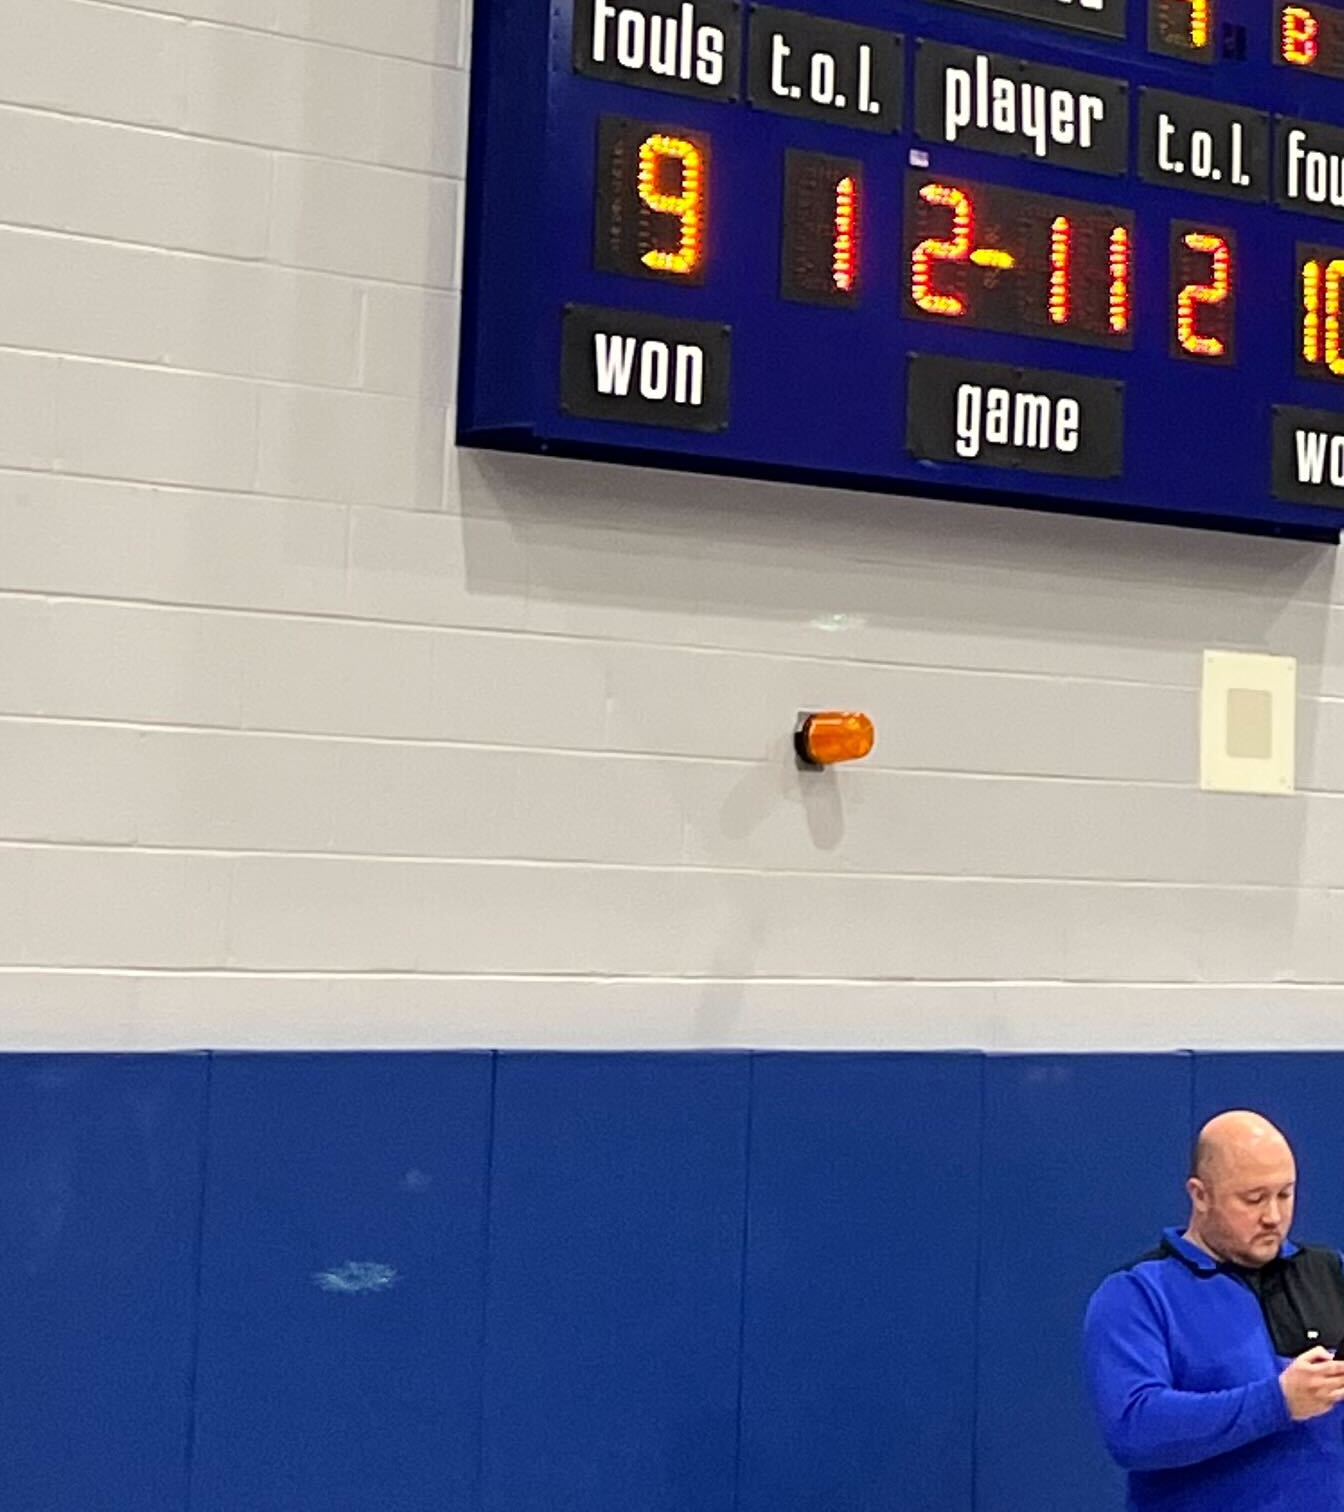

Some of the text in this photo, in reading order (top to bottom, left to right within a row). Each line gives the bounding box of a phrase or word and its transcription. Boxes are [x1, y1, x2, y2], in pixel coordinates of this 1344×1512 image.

[944, 55, 1104, 157] player
[637, 133, 702, 274] 9
[833, 176, 857, 292] 1
[1176, 233, 1230, 356] 2
[594, 332, 704, 407] won
[955, 379, 1080, 459] game
